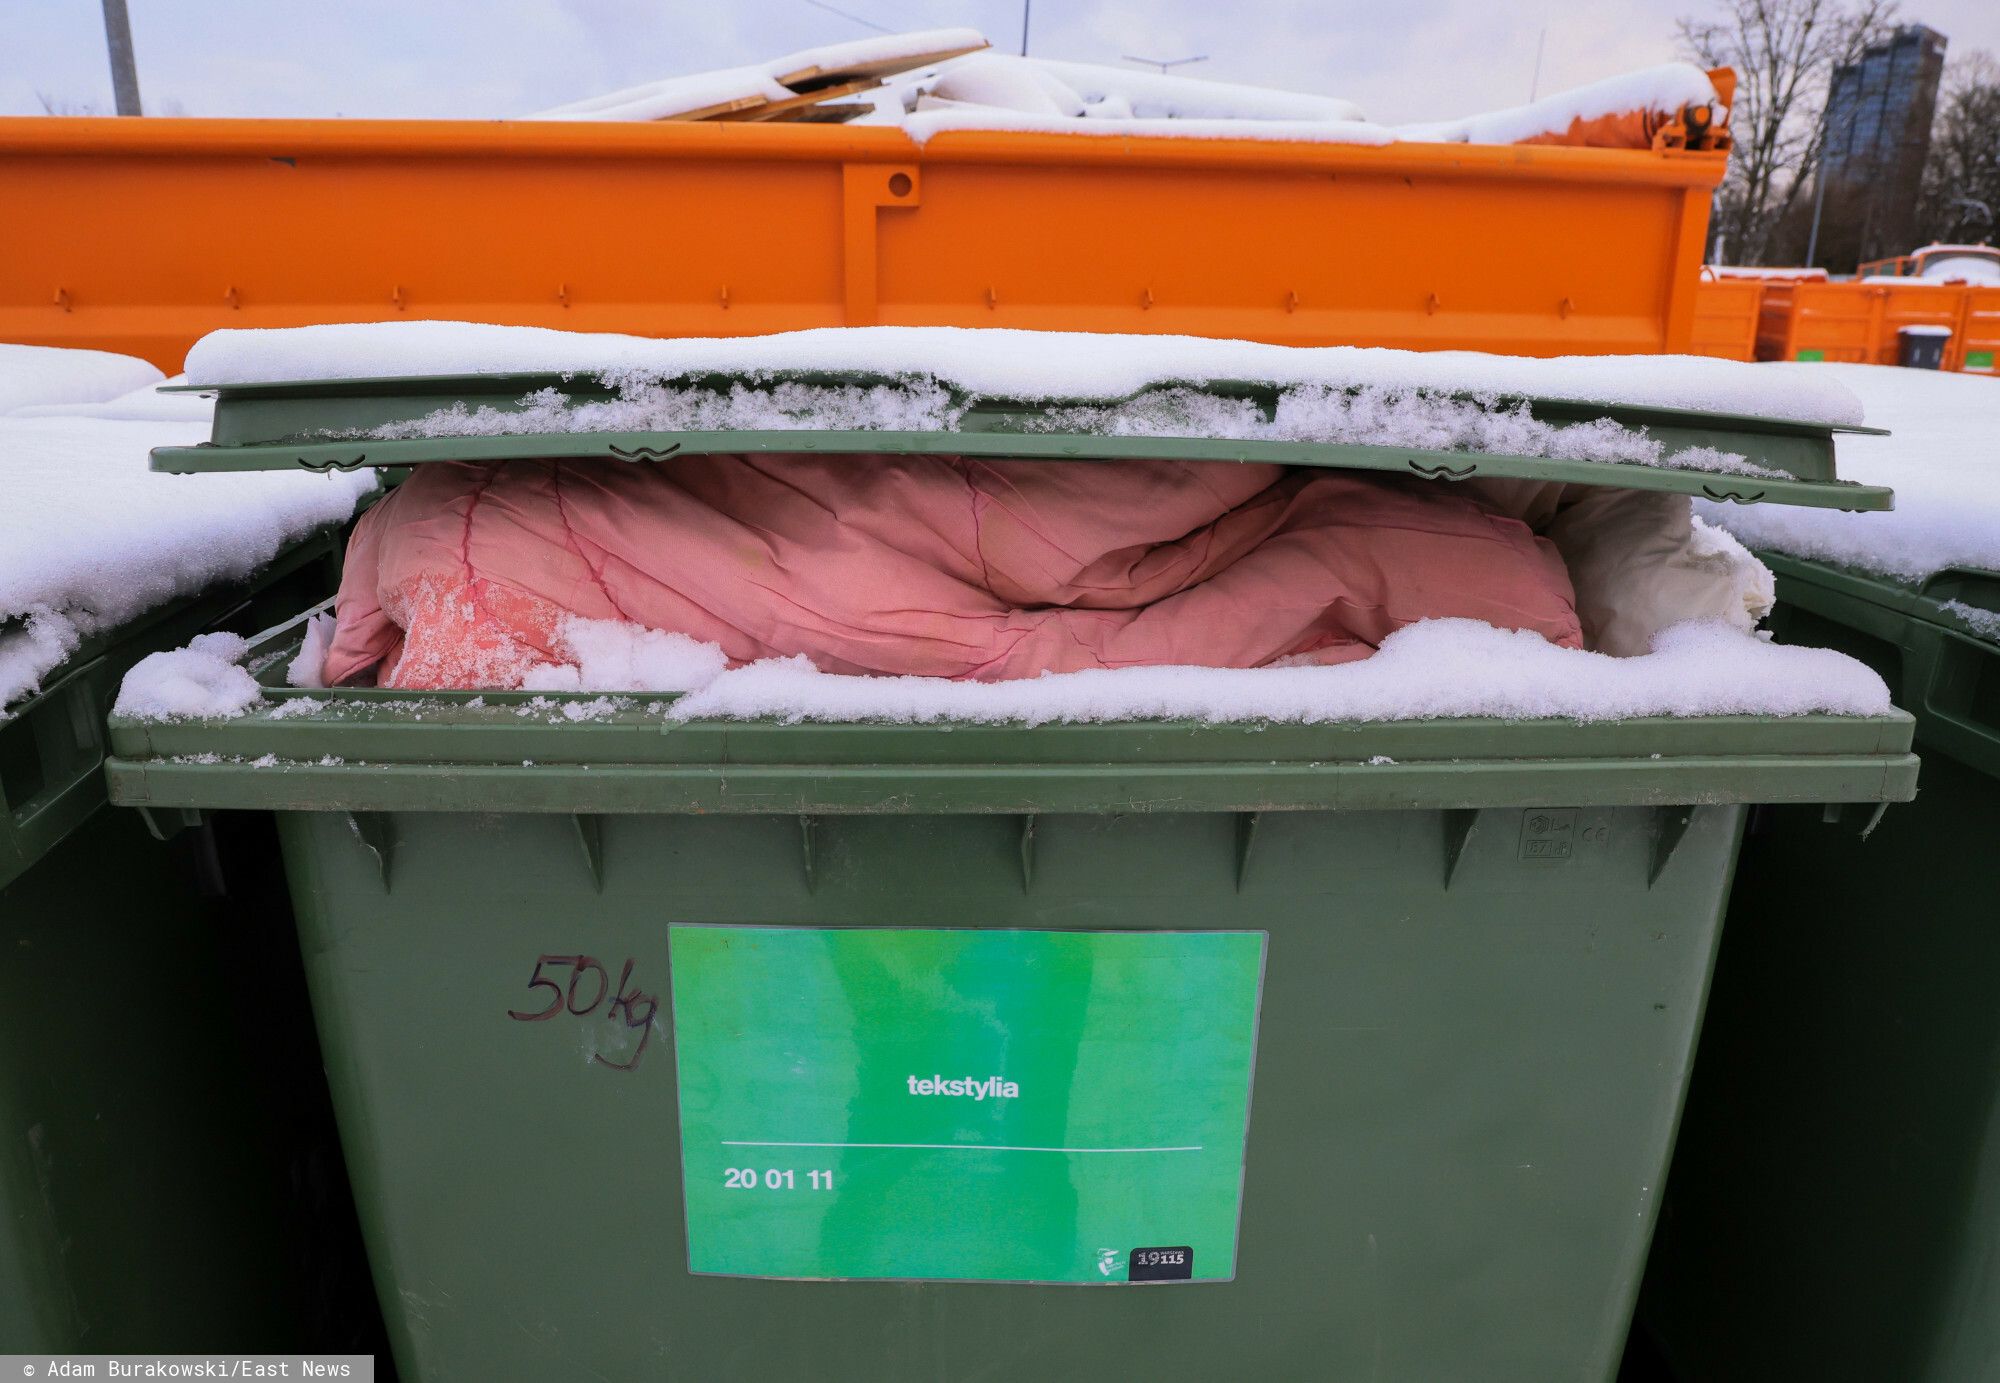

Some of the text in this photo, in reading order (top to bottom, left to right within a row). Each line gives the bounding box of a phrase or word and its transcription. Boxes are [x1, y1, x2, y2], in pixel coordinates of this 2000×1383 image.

[906, 1074, 1020, 1101] tekstylia
[723, 1167, 833, 1190] 20 01 11
